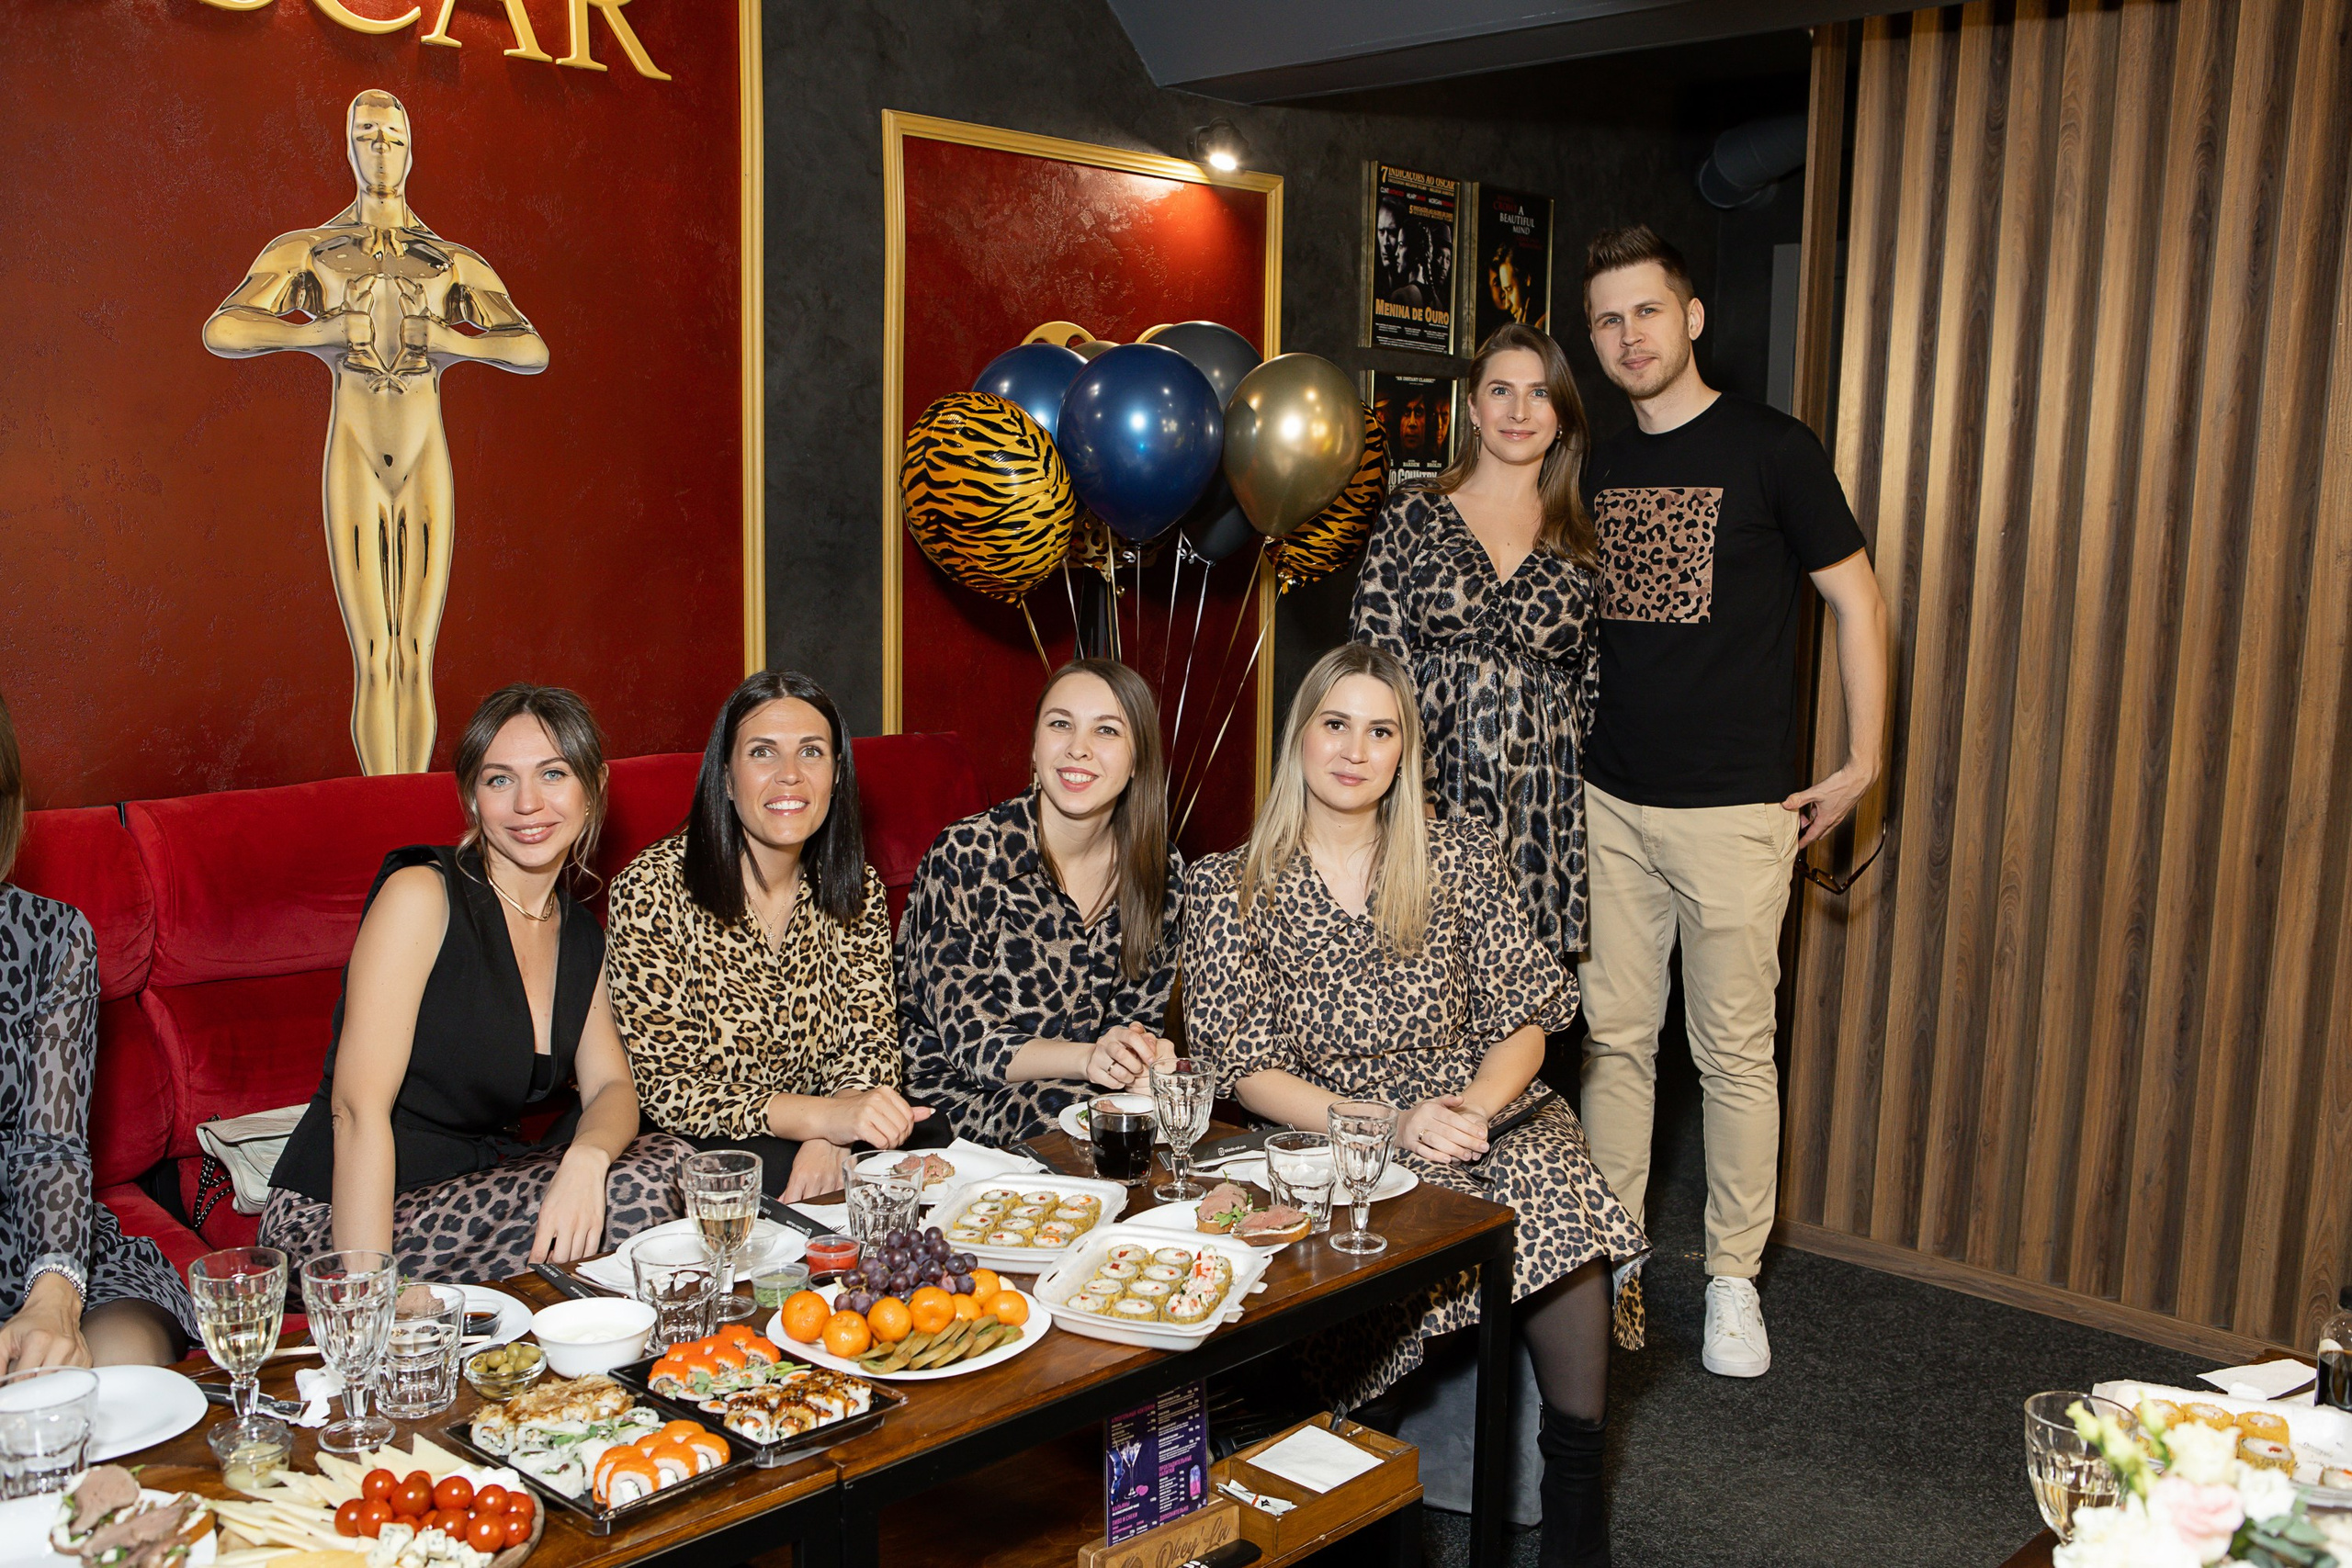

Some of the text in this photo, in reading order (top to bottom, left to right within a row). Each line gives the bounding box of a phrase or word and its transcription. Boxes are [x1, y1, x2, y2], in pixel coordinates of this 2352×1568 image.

[1381, 165, 1388, 183] 7
[1435, 177, 1455, 189] OSCAR
[1518, 205, 1524, 216] A
[1499, 212, 1535, 228] BEAUTIFUL
[1512, 225, 1531, 235] MIND
[1375, 299, 1449, 325] MENINA DE OURO
